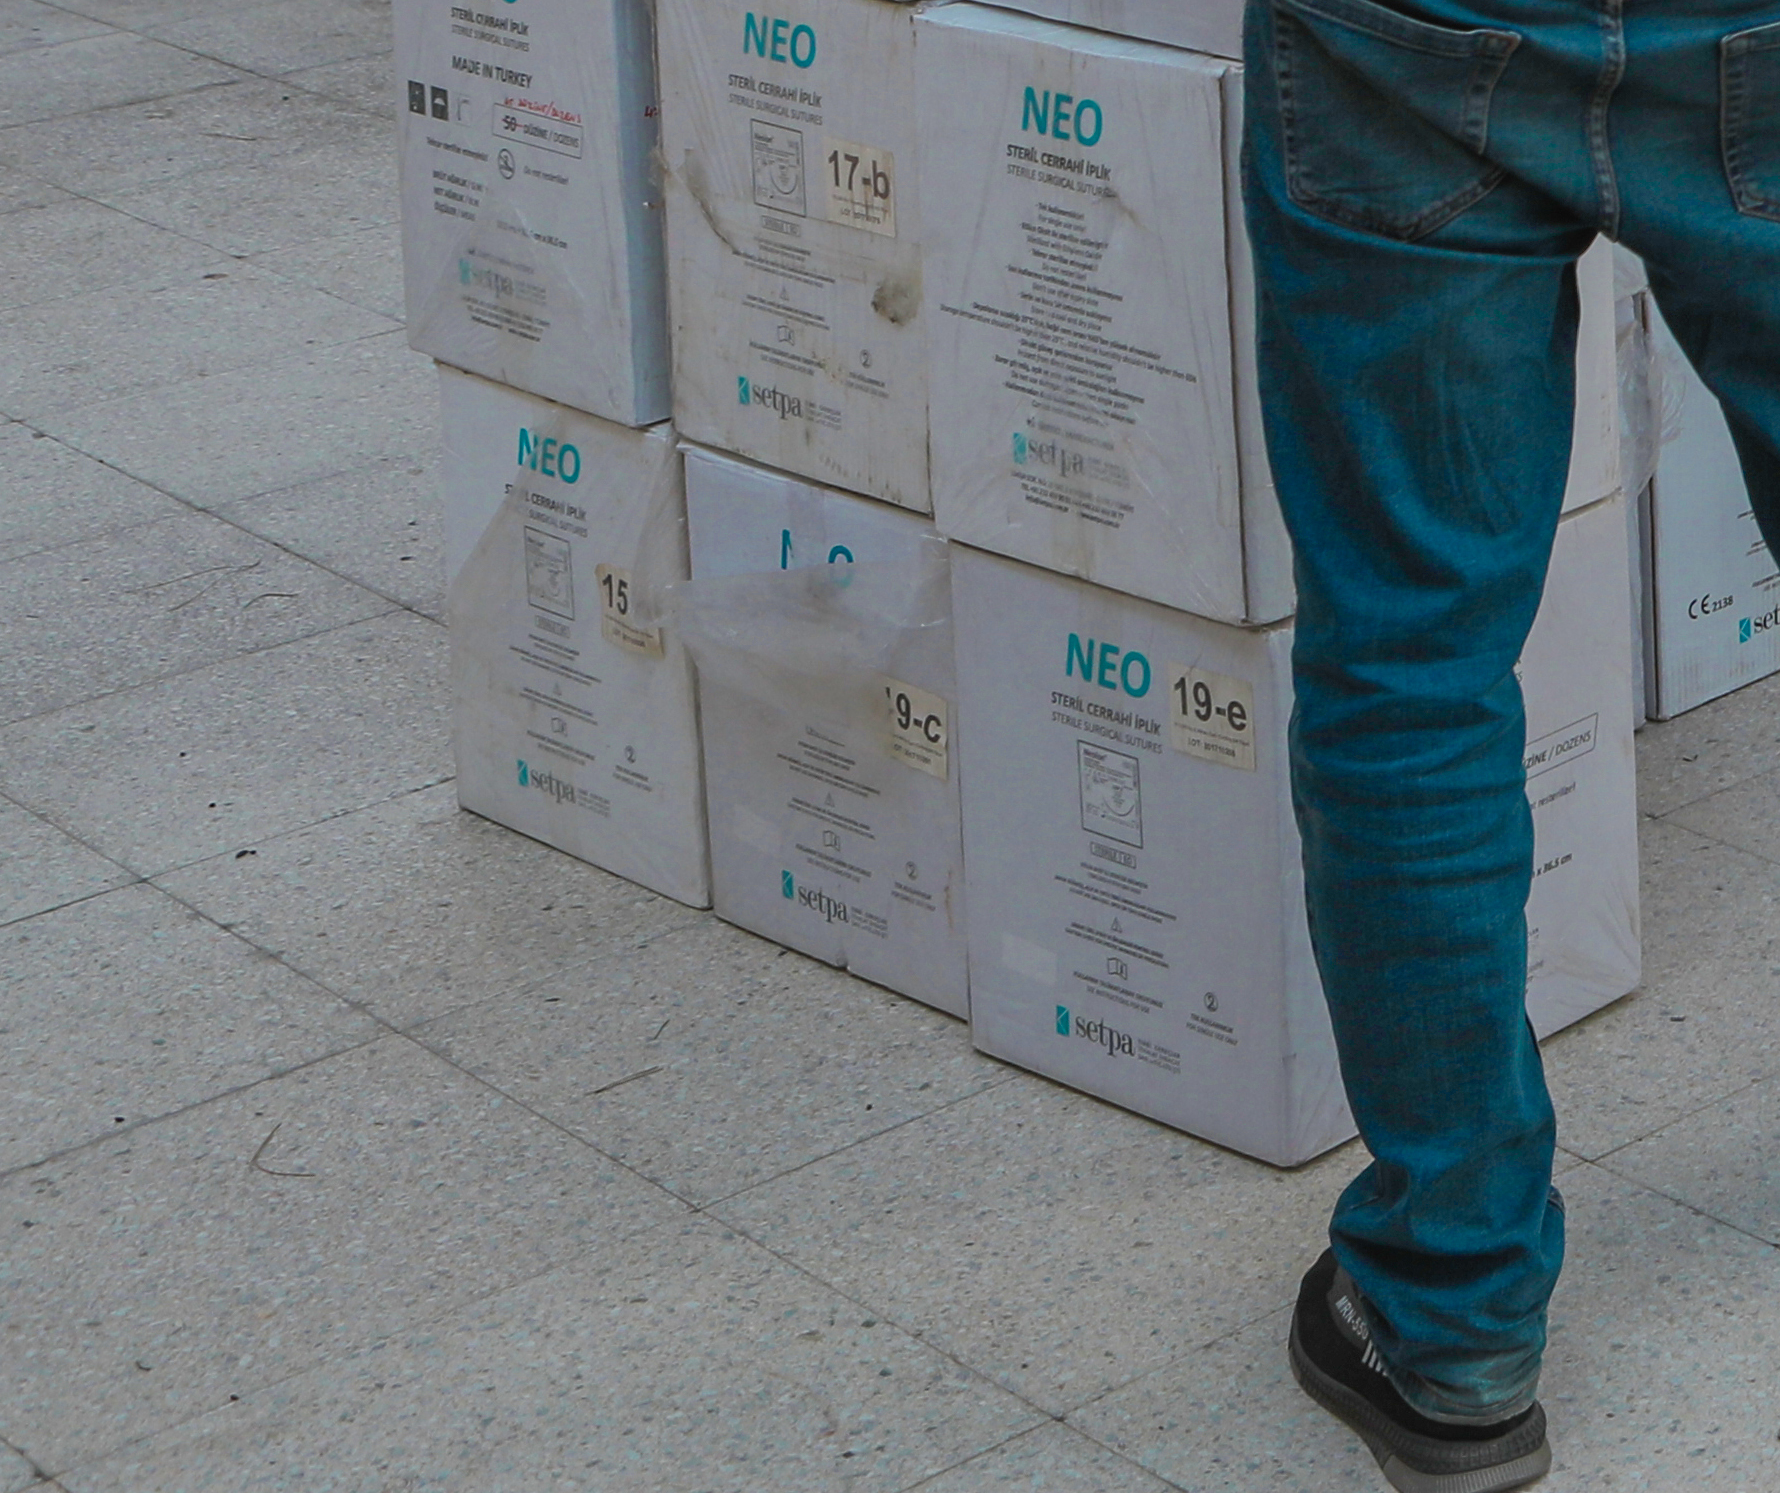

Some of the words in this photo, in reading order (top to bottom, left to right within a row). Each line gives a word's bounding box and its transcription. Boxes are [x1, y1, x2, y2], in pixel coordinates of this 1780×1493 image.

[743, 11, 817, 69] NEO
[452, 56, 480, 76] MADE
[482, 62, 493, 79] IN
[495, 66, 533, 89] TURKEY
[728, 73, 757, 93] STERİL
[758, 80, 798, 101] CERRAHİ
[799, 88, 823, 108] İPLİK
[1022, 86, 1103, 147] NEO
[828, 149, 891, 200] 17-b
[1006, 144, 1039, 164] STERİL
[1041, 152, 1085, 174] CERRAHİ
[1086, 160, 1112, 181] İPLİK
[751, 382, 801, 419] setpa
[518, 427, 581, 484] NEO
[1028, 439, 1084, 478] setpa
[1711, 594, 1734, 612] 2138
[1065, 632, 1152, 699] NEO
[1051, 690, 1085, 713] STERİL
[1087, 701, 1133, 727] CERRAHİ
[1134, 713, 1162, 737] İPLİK
[1174, 675, 1248, 733] 19-e
[1555, 730, 1592, 757] DOZENS
[530, 764, 577, 805] setpa
[797, 881, 848, 924] setpa
[1075, 1015, 1137, 1059] setpa
